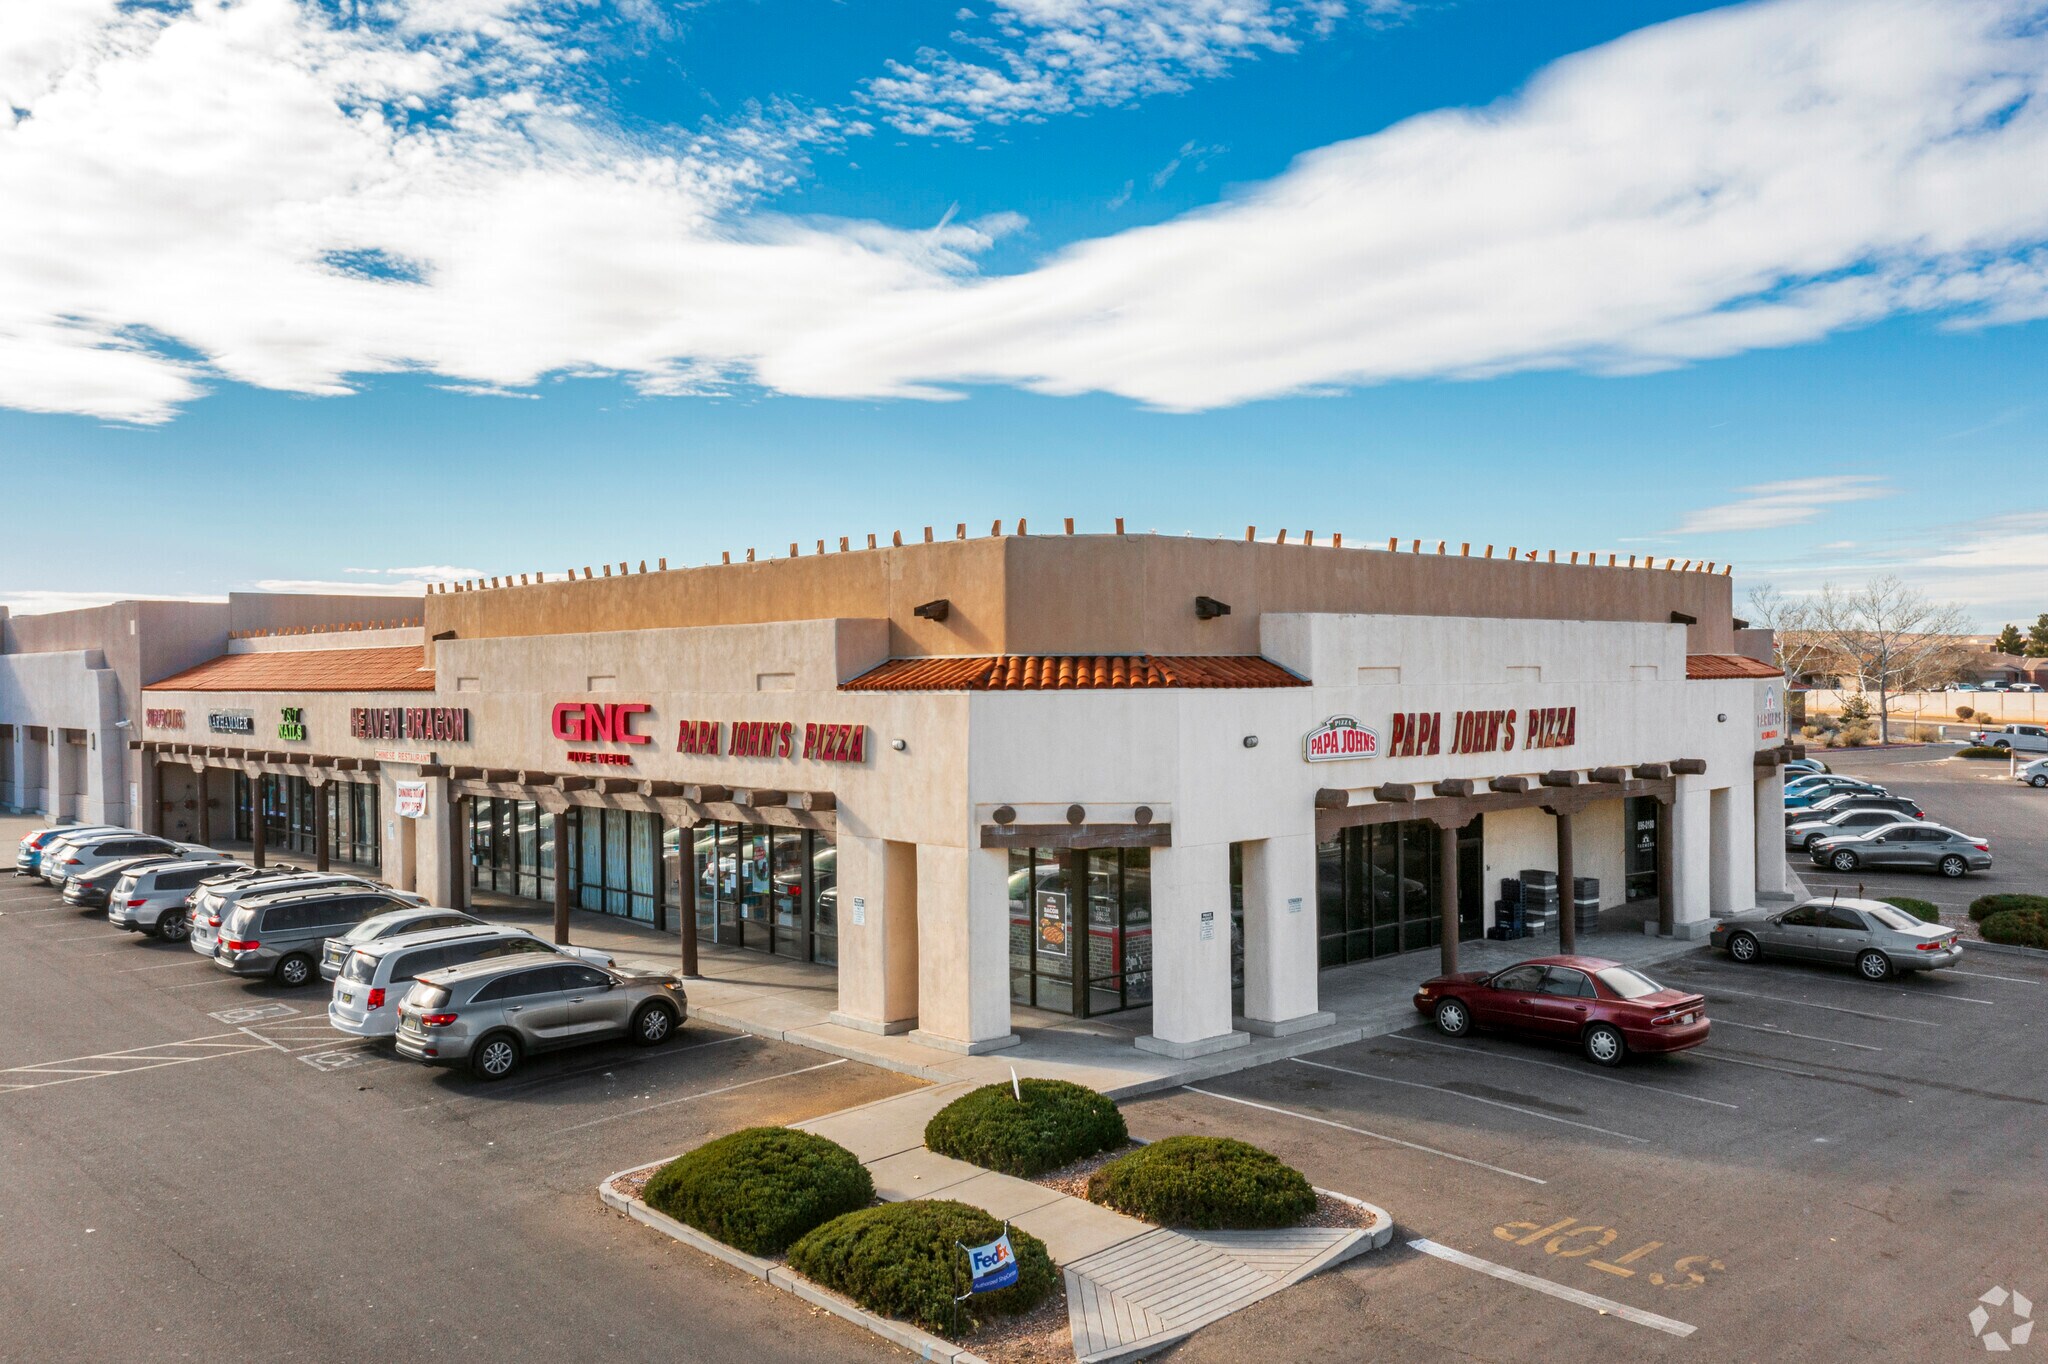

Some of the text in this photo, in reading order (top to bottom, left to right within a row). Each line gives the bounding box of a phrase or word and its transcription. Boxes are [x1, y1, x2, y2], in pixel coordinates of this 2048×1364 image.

[278, 723, 303, 740] NAILS
[350, 707, 467, 741] HEAVEN DRAGON
[552, 703, 650, 744] GNC
[1335, 719, 1353, 727] PIZZA
[1388, 706, 1576, 757] PAPA JOHN'S PIZZA
[677, 720, 868, 763] PAPA JOHN'S PIZZA
[1311, 730, 1339, 755] PAPA
[375, 751, 430, 763] CHINESE RESTAURANT
[567, 752, 595, 763] LIVE
[973, 1243, 1009, 1270] FedEx
[1493, 1217, 1725, 1290] STOP
